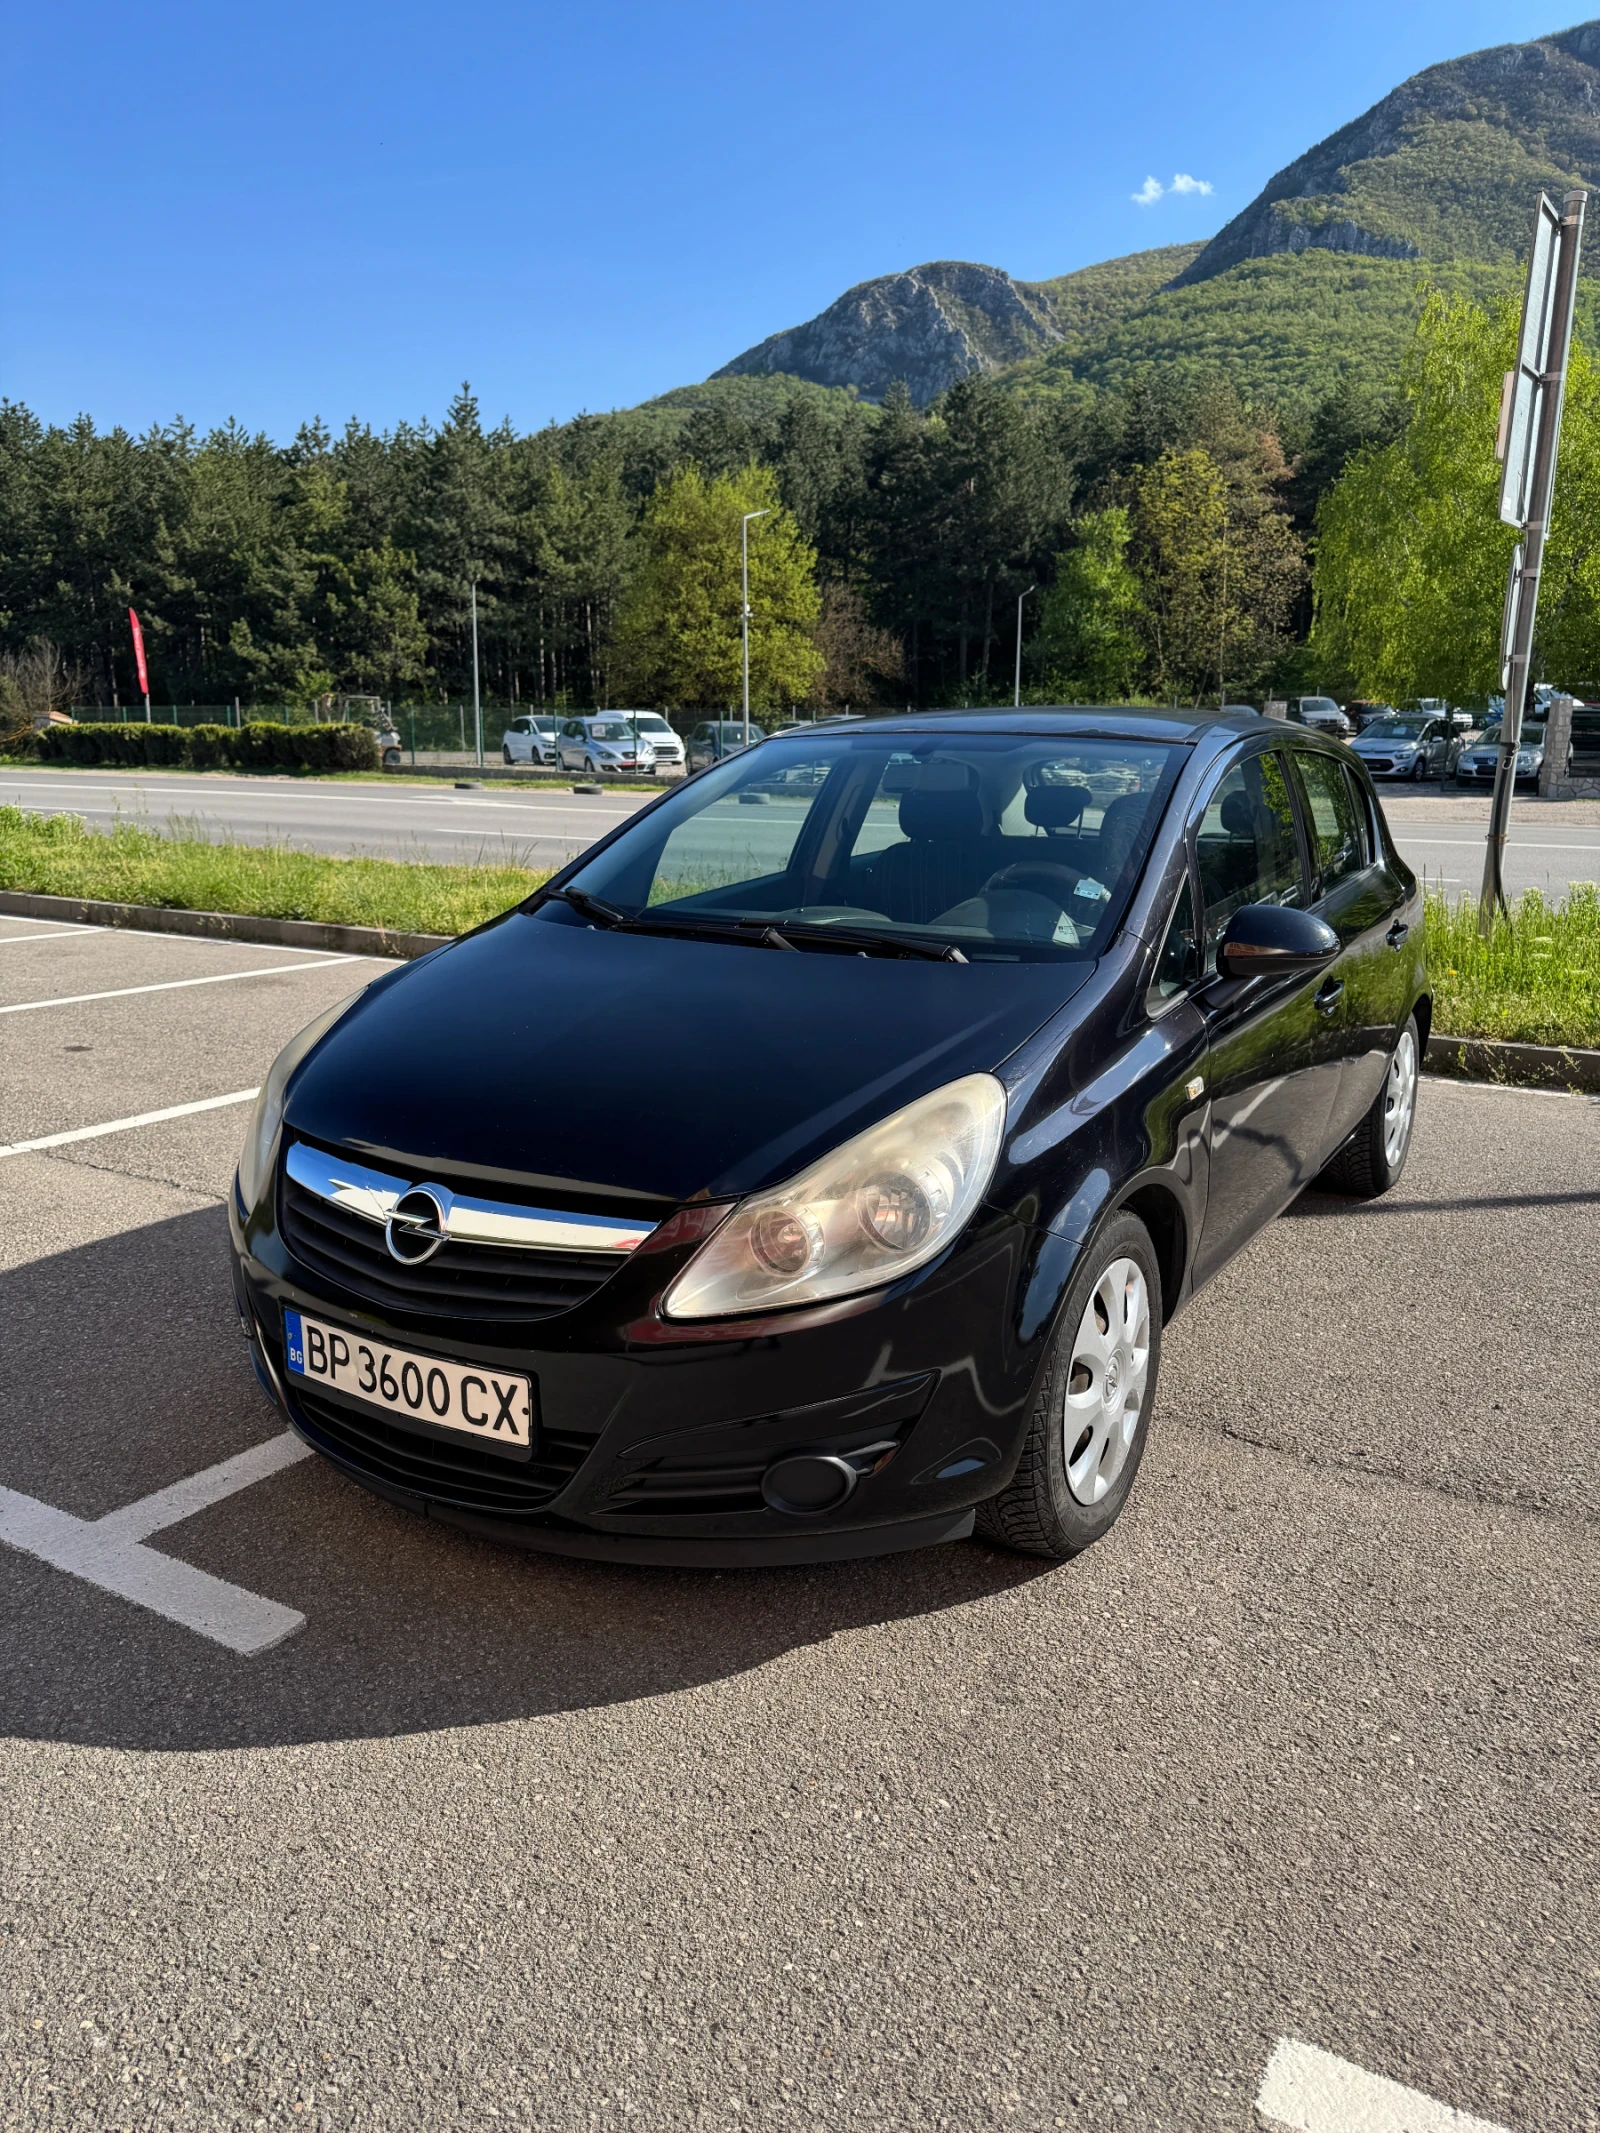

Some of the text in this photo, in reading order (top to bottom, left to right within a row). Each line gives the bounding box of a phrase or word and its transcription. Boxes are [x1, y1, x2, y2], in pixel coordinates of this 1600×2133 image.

[289, 1347, 303, 1364] BG
[306, 1324, 519, 1436] BP 3600 CX
